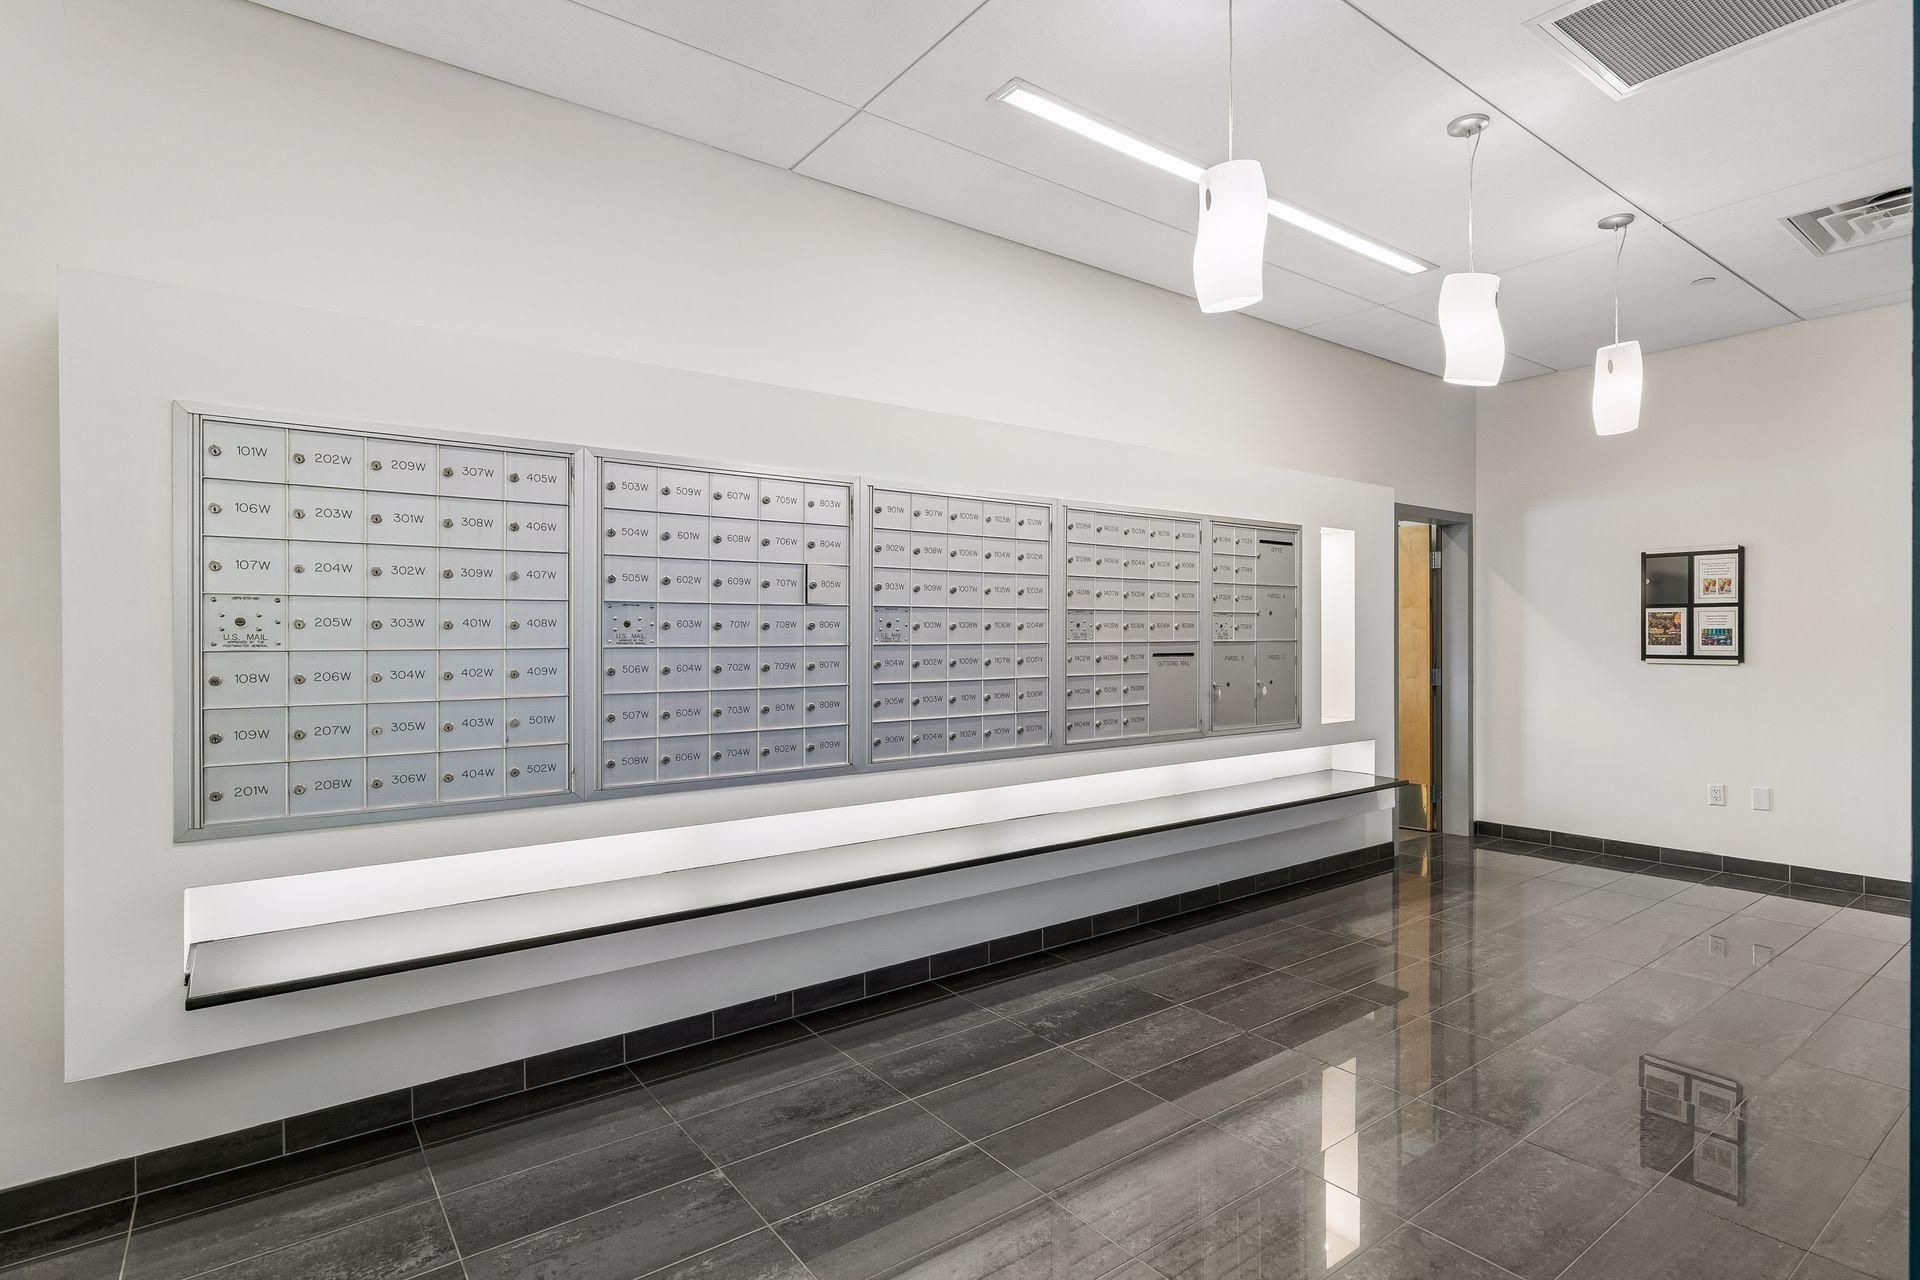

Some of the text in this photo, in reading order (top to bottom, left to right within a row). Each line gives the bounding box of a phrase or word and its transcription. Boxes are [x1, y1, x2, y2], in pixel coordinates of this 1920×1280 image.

[237, 446, 267, 457] 101W
[315, 454, 352, 465] 202W
[391, 460, 426, 471] 209W
[462, 467, 494, 478] 307W
[527, 473, 557, 483] 405W
[622, 482, 648, 491] 503W
[677, 487, 701, 496] 509W
[727, 492, 750, 500] 607W
[776, 496, 797, 504] 705W
[820, 500, 840, 508] 803W
[235, 503, 270, 514] 106W
[315, 508, 352, 519] 203W
[393, 514, 424, 524] 301W
[461, 517, 493, 528] 308W
[527, 522, 556, 531] 406W
[622, 528, 648, 536] 504W
[678, 532, 700, 540] 601W
[728, 535, 751, 543] 608W
[236, 560, 271, 571] 107W
[315, 563, 352, 573] 204W
[391, 566, 425, 576] 302W
[461, 568, 492, 578] 309W
[527, 570, 556, 580] 407W
[622, 574, 648, 582] 505W
[677, 576, 701, 584] 602W
[776, 579, 797, 587] 707W
[315, 618, 352, 627] 205W
[390, 618, 424, 628] 303W
[462, 619, 491, 628] 401W
[527, 619, 557, 628] 408W
[677, 620, 701, 628] 603W
[527, 667, 557, 676] 409W
[622, 665, 649, 673] 506W
[677, 664, 701, 672] 604W
[314, 672, 351, 682] 206W
[390, 670, 425, 679] 304W
[461, 668, 493, 678] 402W
[236, 673, 270, 683] 108W
[819, 701, 840, 709] 808W
[676, 708, 701, 717] 605W
[727, 706, 750, 714] 703W
[529, 715, 555, 724] 501W
[622, 711, 648, 720] 507W
[391, 722, 425, 732] 305W
[462, 718, 494, 728] 403W
[234, 730, 270, 740] 109W
[314, 726, 351, 736] 207W
[727, 748, 750, 756] 704W
[622, 756, 648, 765] 508W
[676, 753, 700, 761] 606W
[527, 763, 556, 773] 502W
[462, 768, 494, 778] 404W
[392, 773, 426, 784] 306W
[315, 779, 352, 790] 208W
[234, 785, 268, 797] 201W
